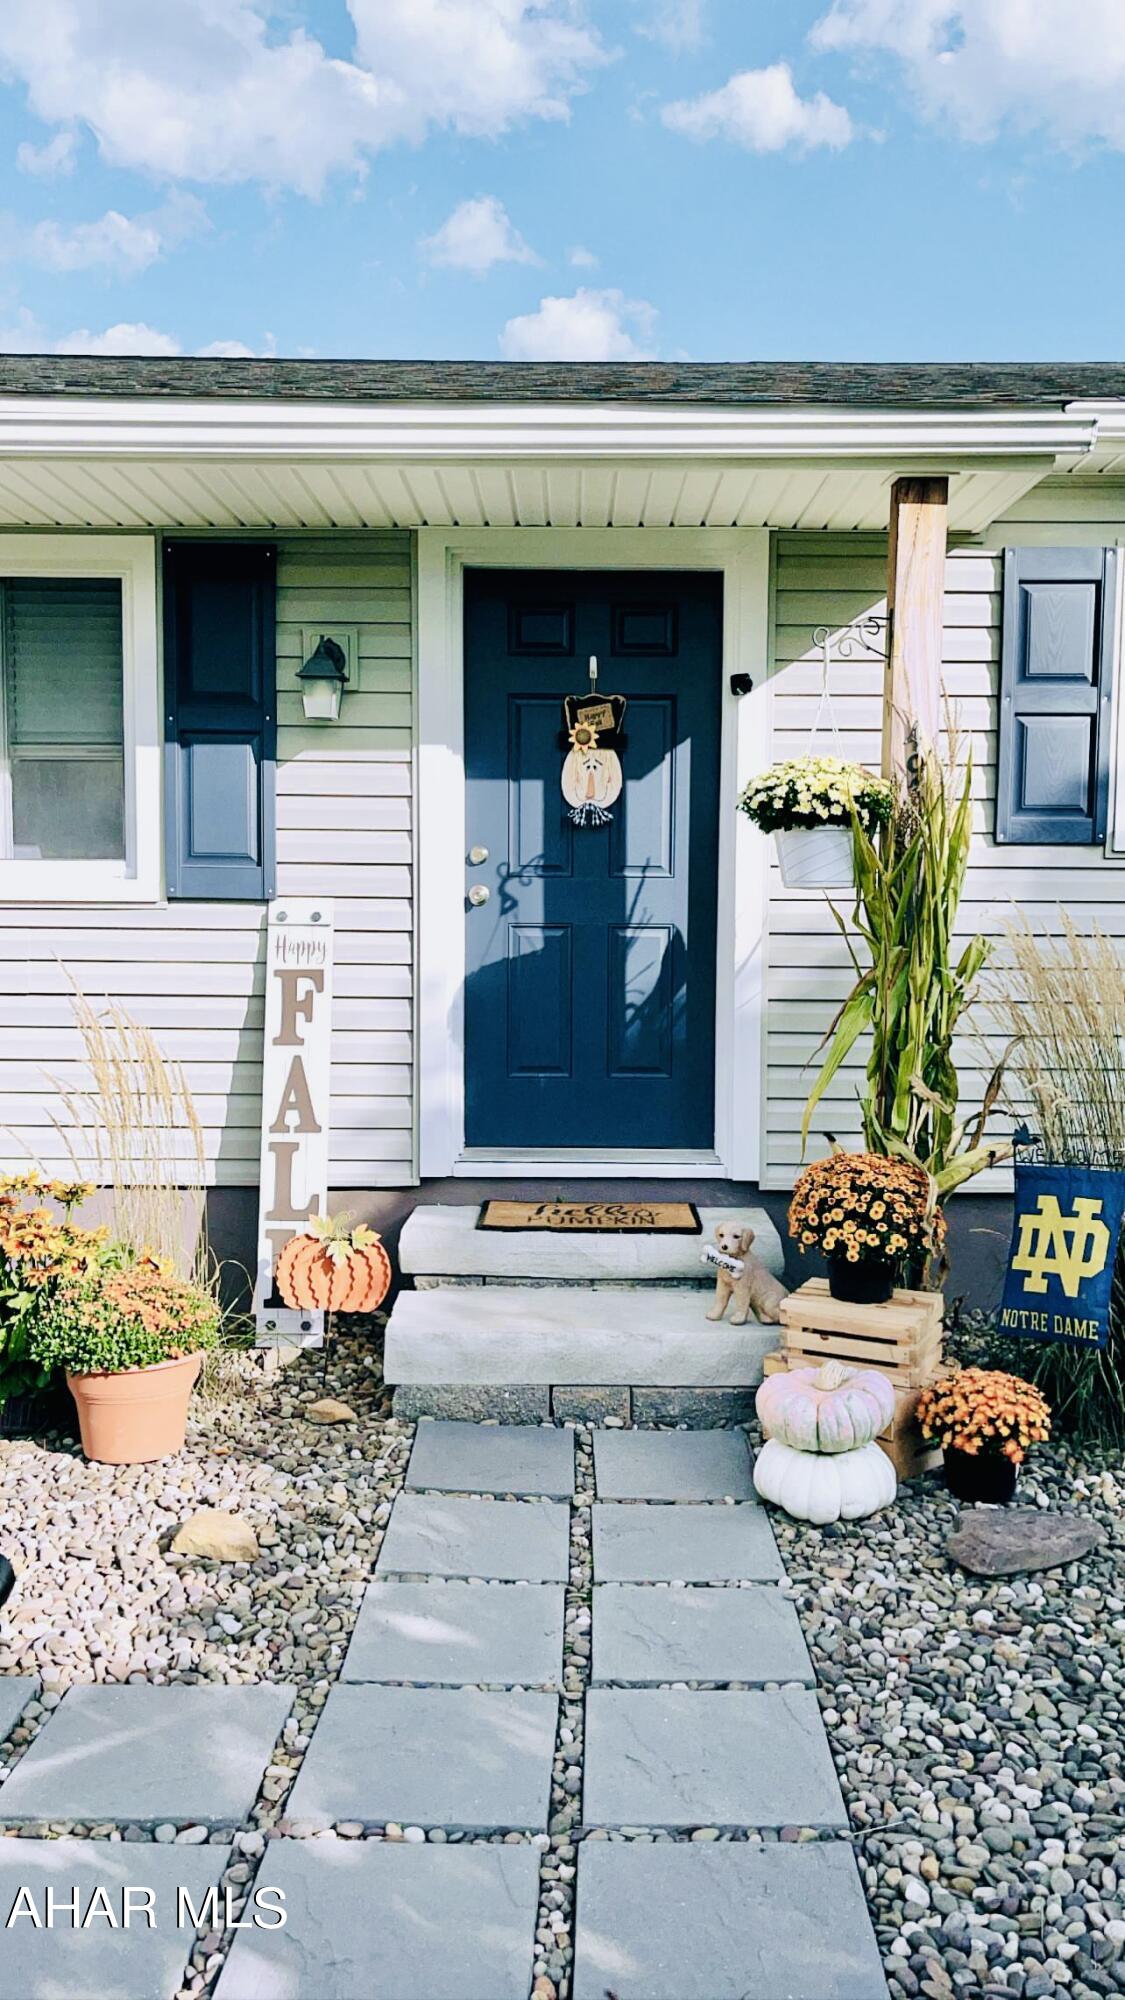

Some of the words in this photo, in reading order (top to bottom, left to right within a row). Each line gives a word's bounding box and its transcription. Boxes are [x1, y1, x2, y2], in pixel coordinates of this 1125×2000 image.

[275, 934, 326, 966] Happy
[527, 1215, 655, 1225] PUMPKIN
[706, 1253, 737, 1272] WELCOME
[1000, 1308, 1048, 1332] NOTRE
[1054, 1315, 1099, 1340] DAME
